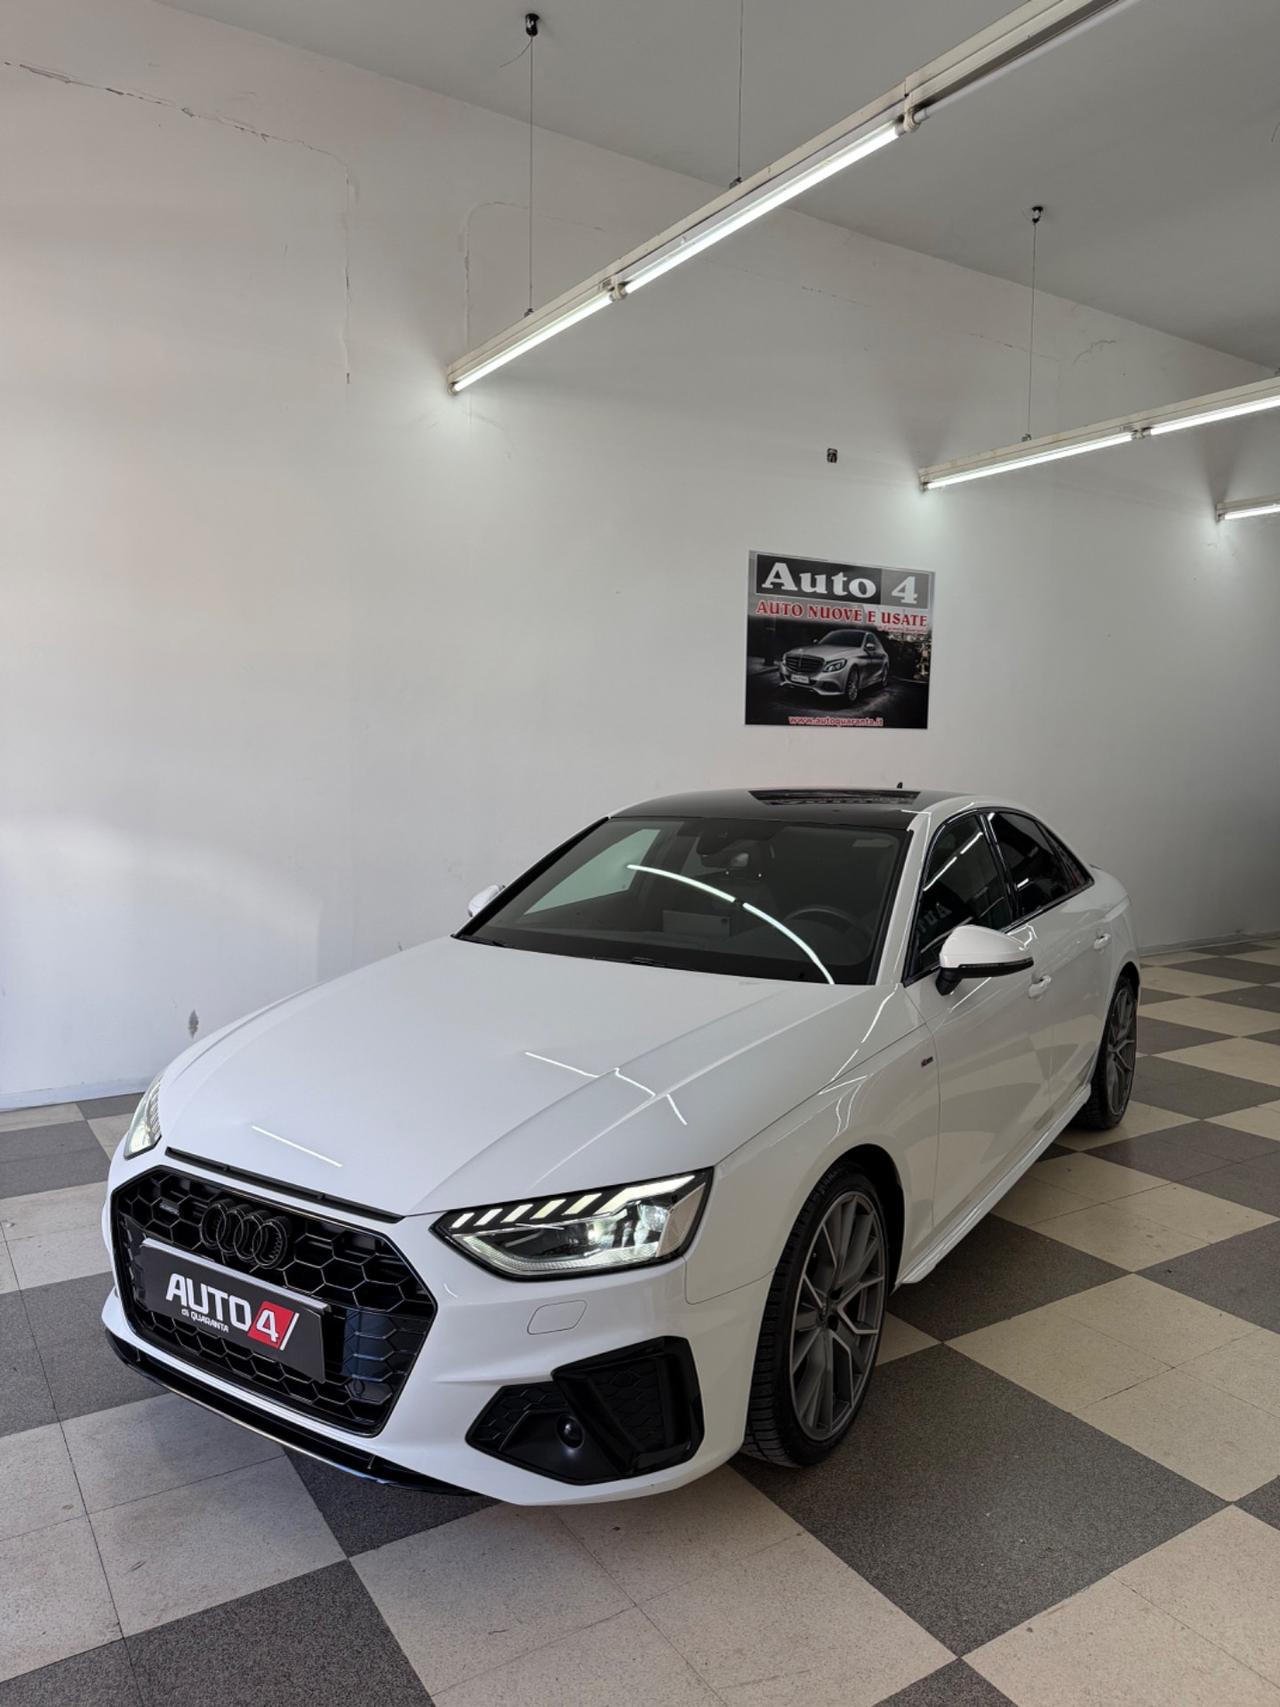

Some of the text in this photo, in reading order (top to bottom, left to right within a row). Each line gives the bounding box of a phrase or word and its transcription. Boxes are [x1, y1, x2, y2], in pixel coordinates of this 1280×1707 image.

[761, 562, 918, 604] Auto 4
[757, 600, 928, 627] AUTO NUOVE E USATE
[191, 1311, 229, 1333] QUARANTA
